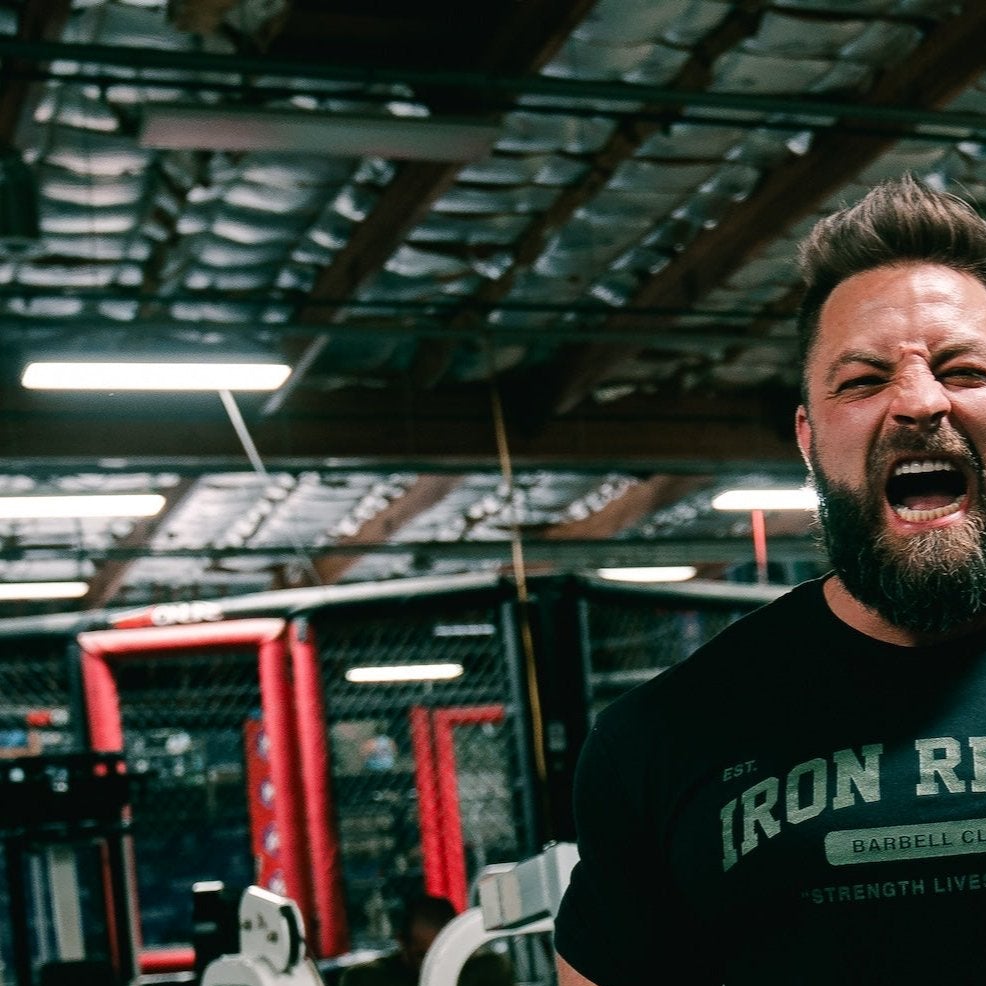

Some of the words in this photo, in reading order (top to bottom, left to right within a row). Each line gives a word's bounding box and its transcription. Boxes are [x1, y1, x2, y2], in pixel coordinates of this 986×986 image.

[722, 759, 758, 782] EST.
[720, 743, 884, 873] IRON
[852, 831, 954, 853] BARBELL
